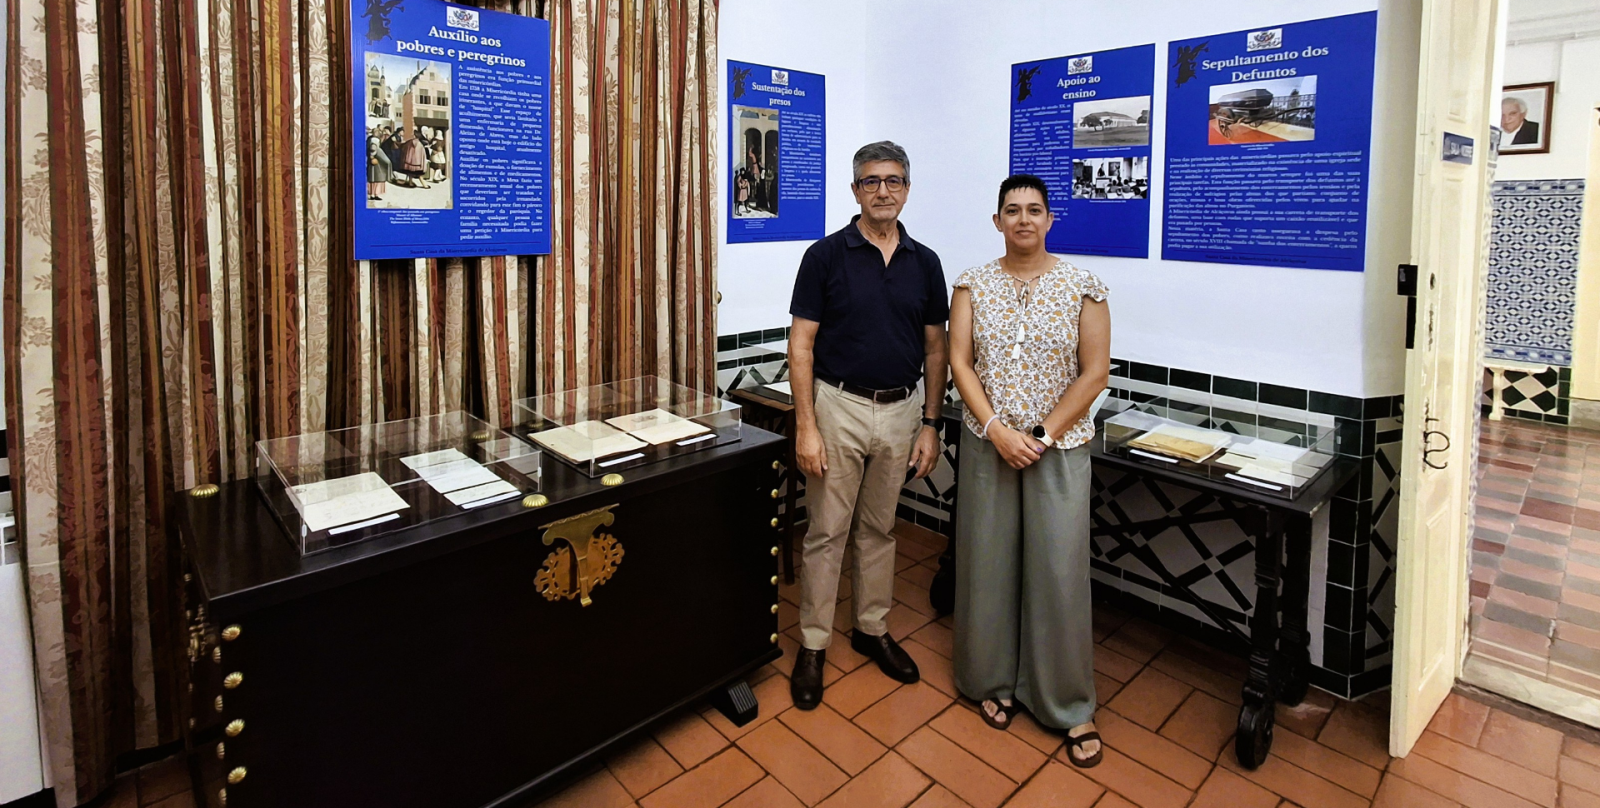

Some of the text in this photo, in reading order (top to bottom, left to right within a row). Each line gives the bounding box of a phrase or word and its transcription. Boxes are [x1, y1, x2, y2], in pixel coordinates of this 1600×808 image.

[428, 26, 501, 48] Auxílio aos
[396, 40, 526, 67] pobres e peregrinos
[1202, 45, 1329, 71] Sepultamento dos
[1056, 75, 1101, 89] Apoio ao
[1231, 67, 1297, 83] Defuntos
[752, 82, 805, 97] Sustentação dos
[1062, 89, 1097, 100] ensino
[769, 98, 791, 106] presos
